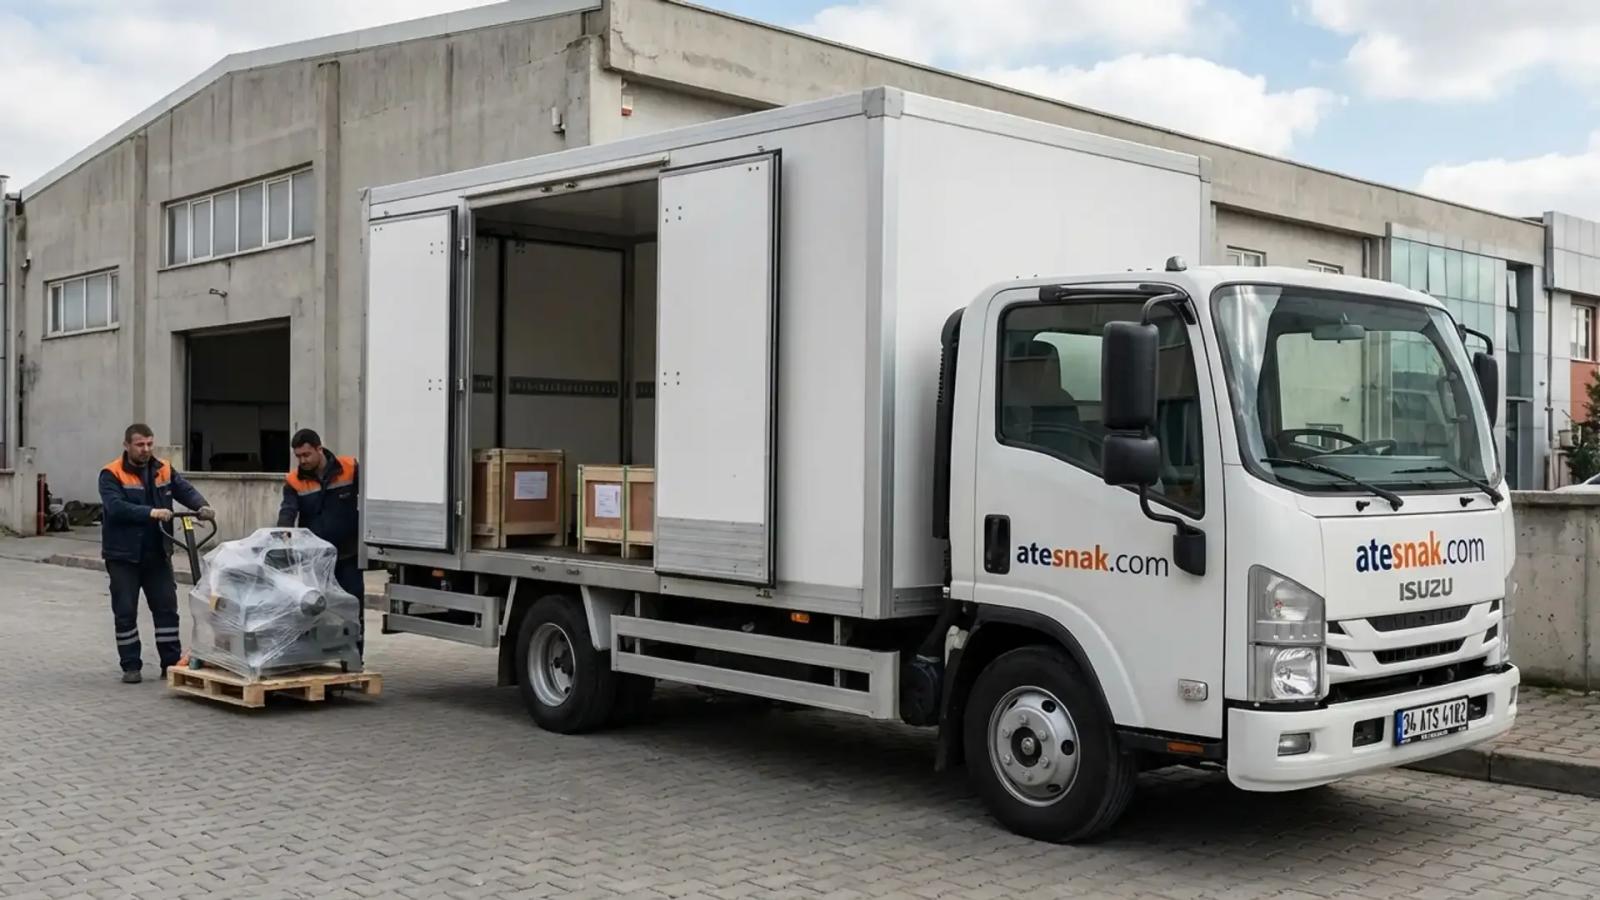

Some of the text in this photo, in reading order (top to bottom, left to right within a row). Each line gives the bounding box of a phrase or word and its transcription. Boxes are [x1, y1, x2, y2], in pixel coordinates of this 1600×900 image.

[1017, 542, 1169, 577] atesnak.com
[1356, 531, 1485, 573] atesnak.com
[1400, 577, 1453, 601] ISUZU
[1403, 711, 1417, 735] 34
[1420, 707, 1439, 732] ATS
